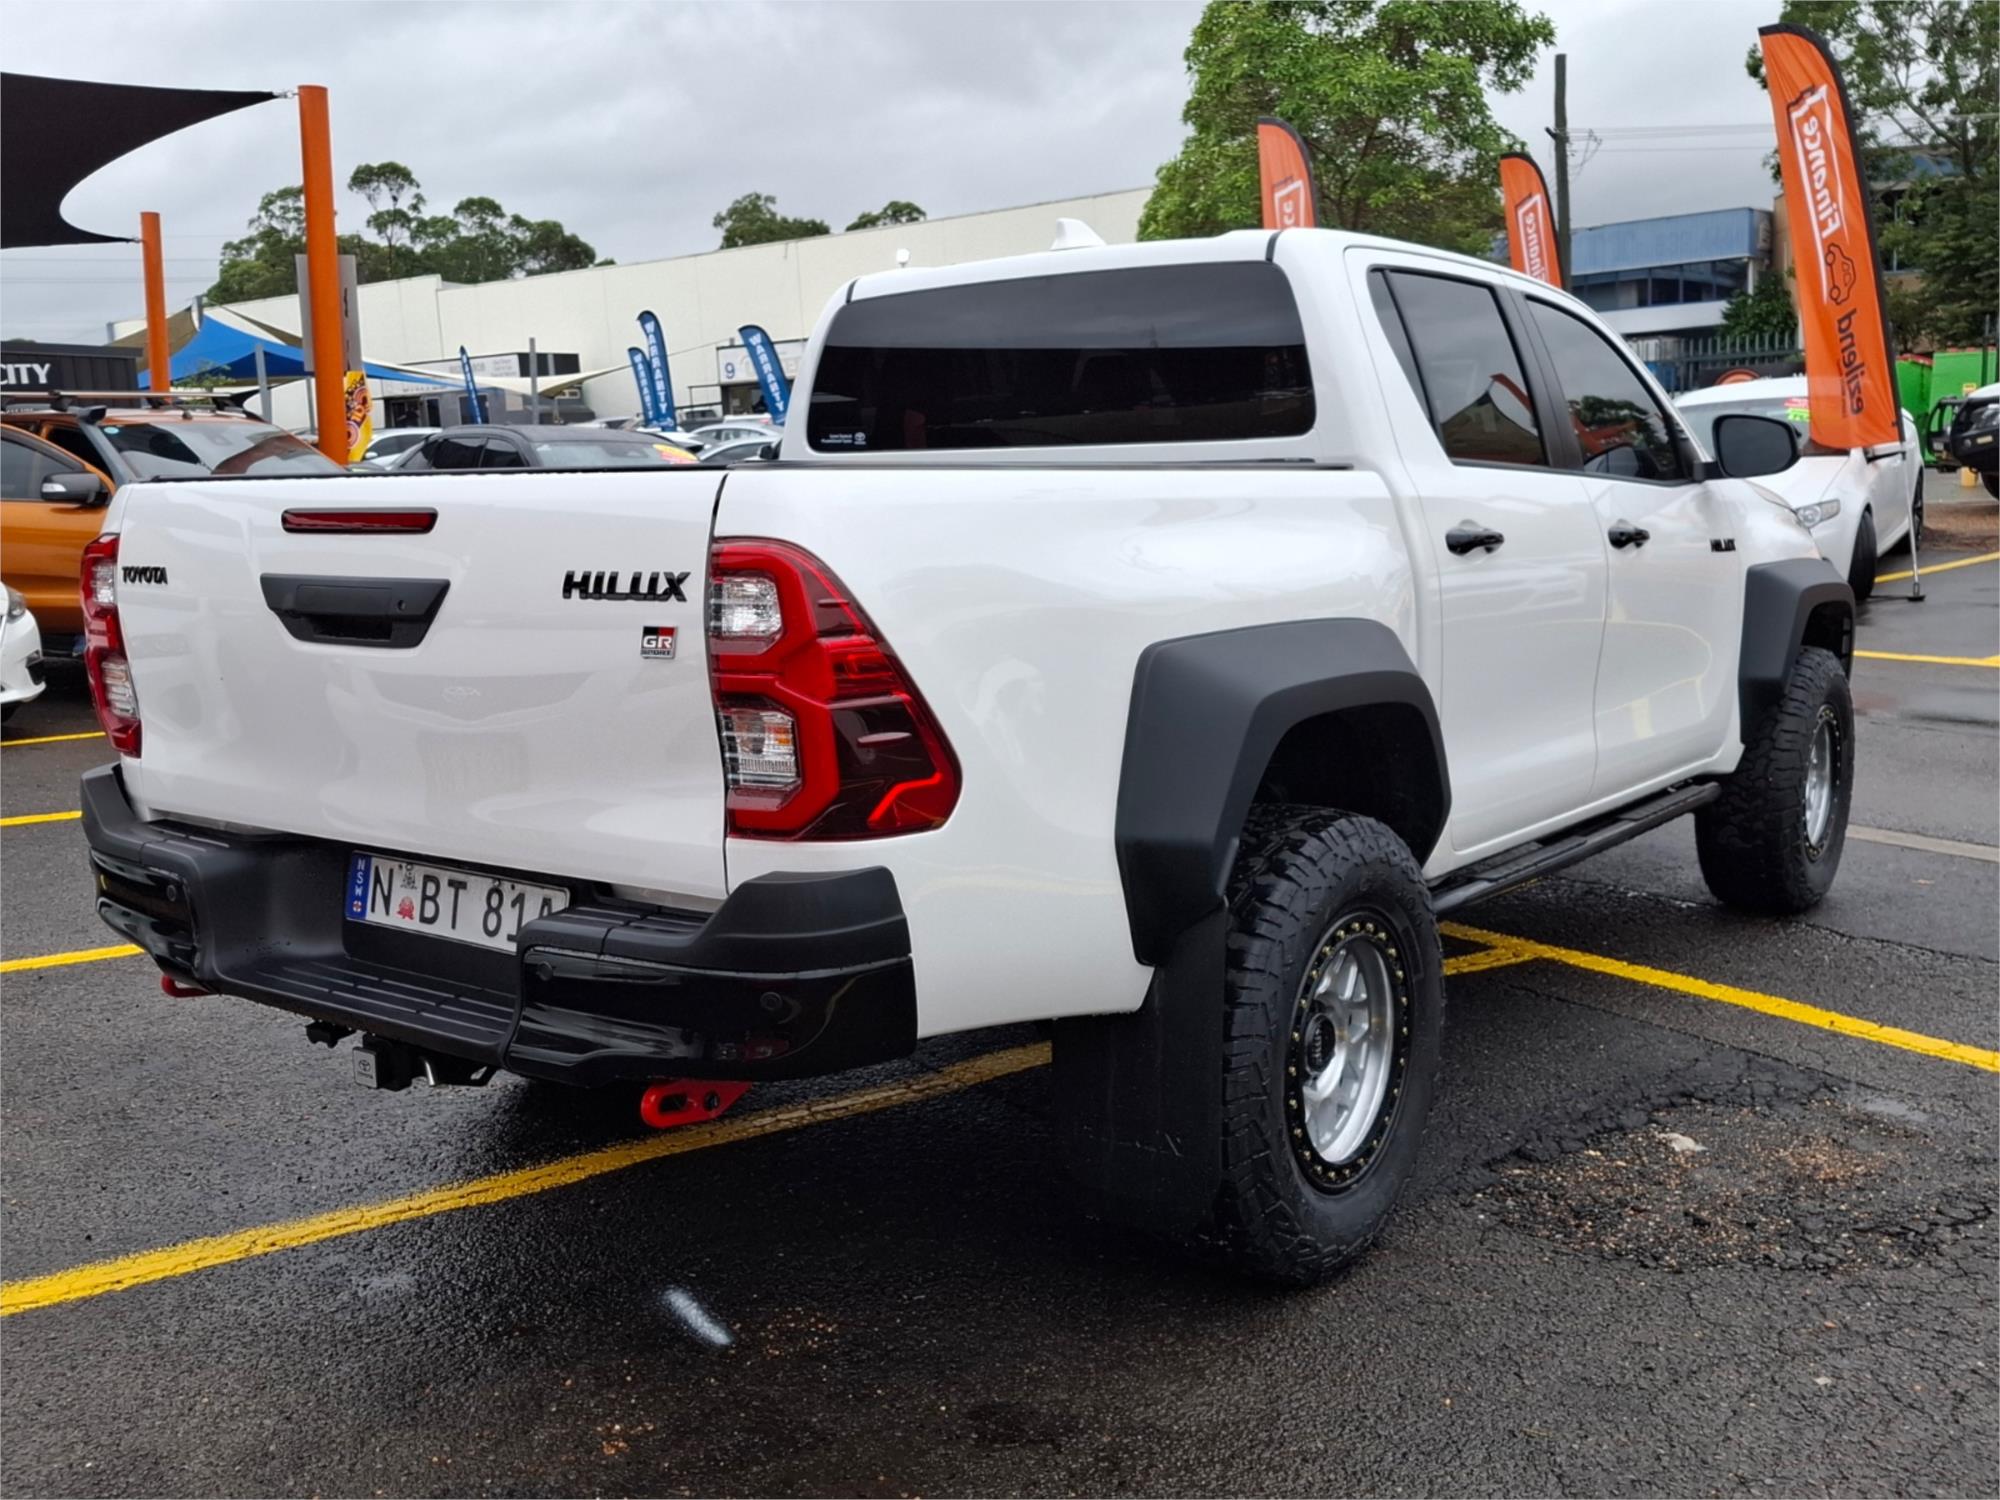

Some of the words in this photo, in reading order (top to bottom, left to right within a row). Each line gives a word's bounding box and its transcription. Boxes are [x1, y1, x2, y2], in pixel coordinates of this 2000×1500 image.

[644, 321, 668, 414] WARRANTY
[724, 362, 736, 379] 9
[749, 332, 785, 412] WARRANTY
[121, 566, 168, 585] TOYOTA
[562, 570, 691, 602] HILUX
[642, 635, 673, 649] GR
[354, 858, 366, 897] NSW
